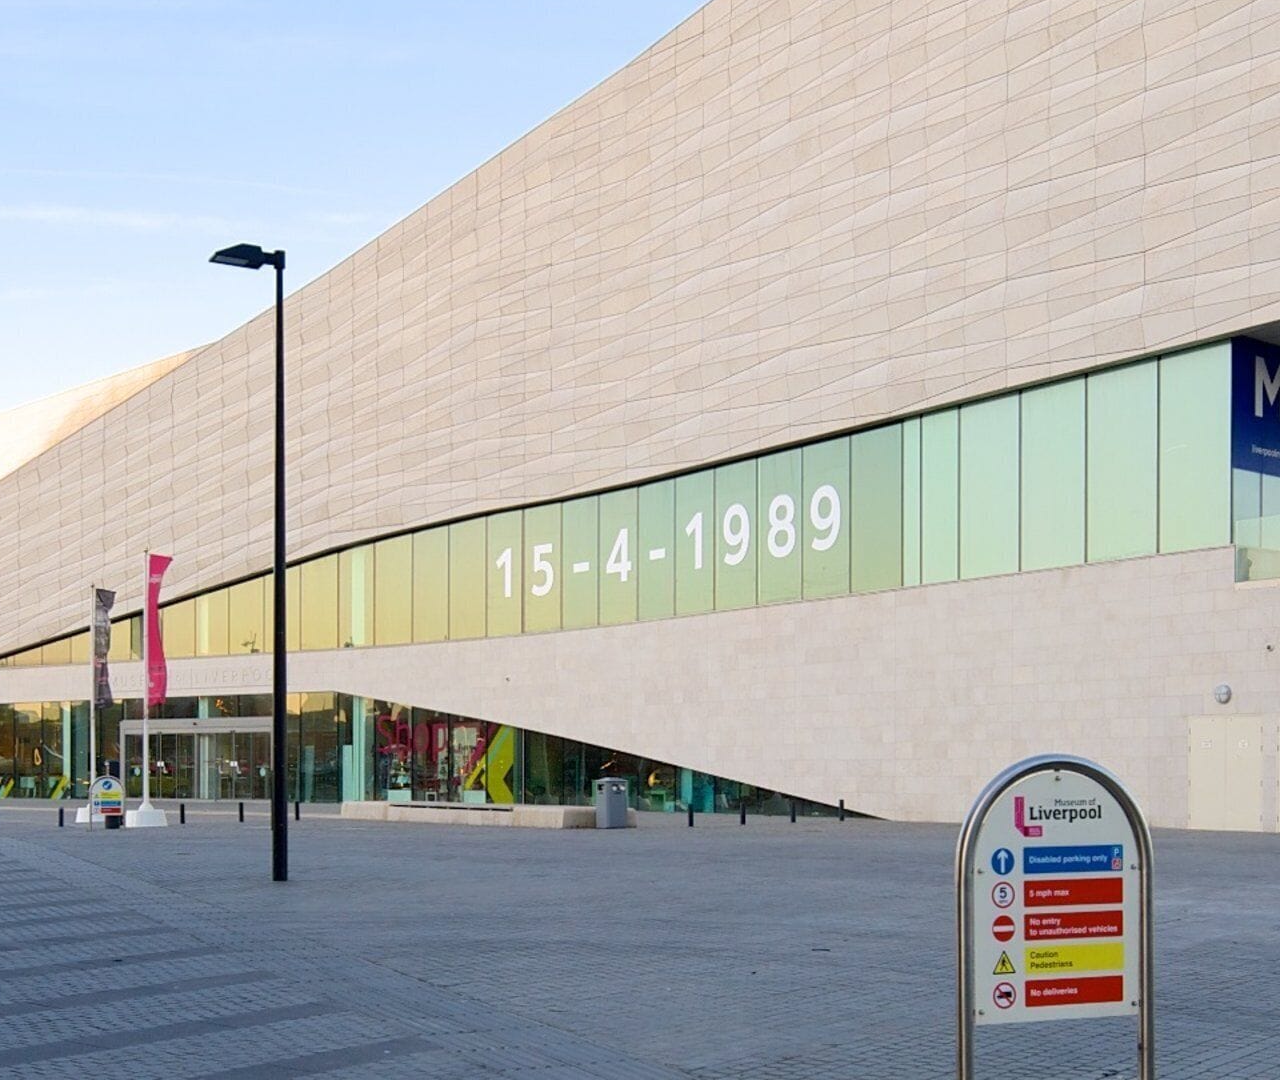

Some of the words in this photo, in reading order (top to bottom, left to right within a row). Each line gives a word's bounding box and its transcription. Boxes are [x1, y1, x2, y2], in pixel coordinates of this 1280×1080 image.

[377, 715, 448, 762] Shop
[1054, 798, 1087, 807] Museum
[1088, 797, 1096, 806] of
[1029, 805, 1102, 823] Liverpool
[1028, 855, 1062, 864] Disabled
[1062, 854, 1091, 864] parking
[1092, 853, 1108, 863] only
[999, 886, 1008, 899] 5
[1035, 889, 1053, 898] mph
[1029, 918, 1040, 926] No
[1042, 917, 1061, 926] entry
[1029, 928, 1037, 936] to
[1039, 926, 1088, 936] unauthorised
[1089, 924, 1118, 934] vehicles
[1030, 951, 1059, 959] Caution
[1030, 960, 1073, 969] Pedestrians
[1030, 989, 1041, 997] No
[1042, 987, 1078, 996] deliveries
